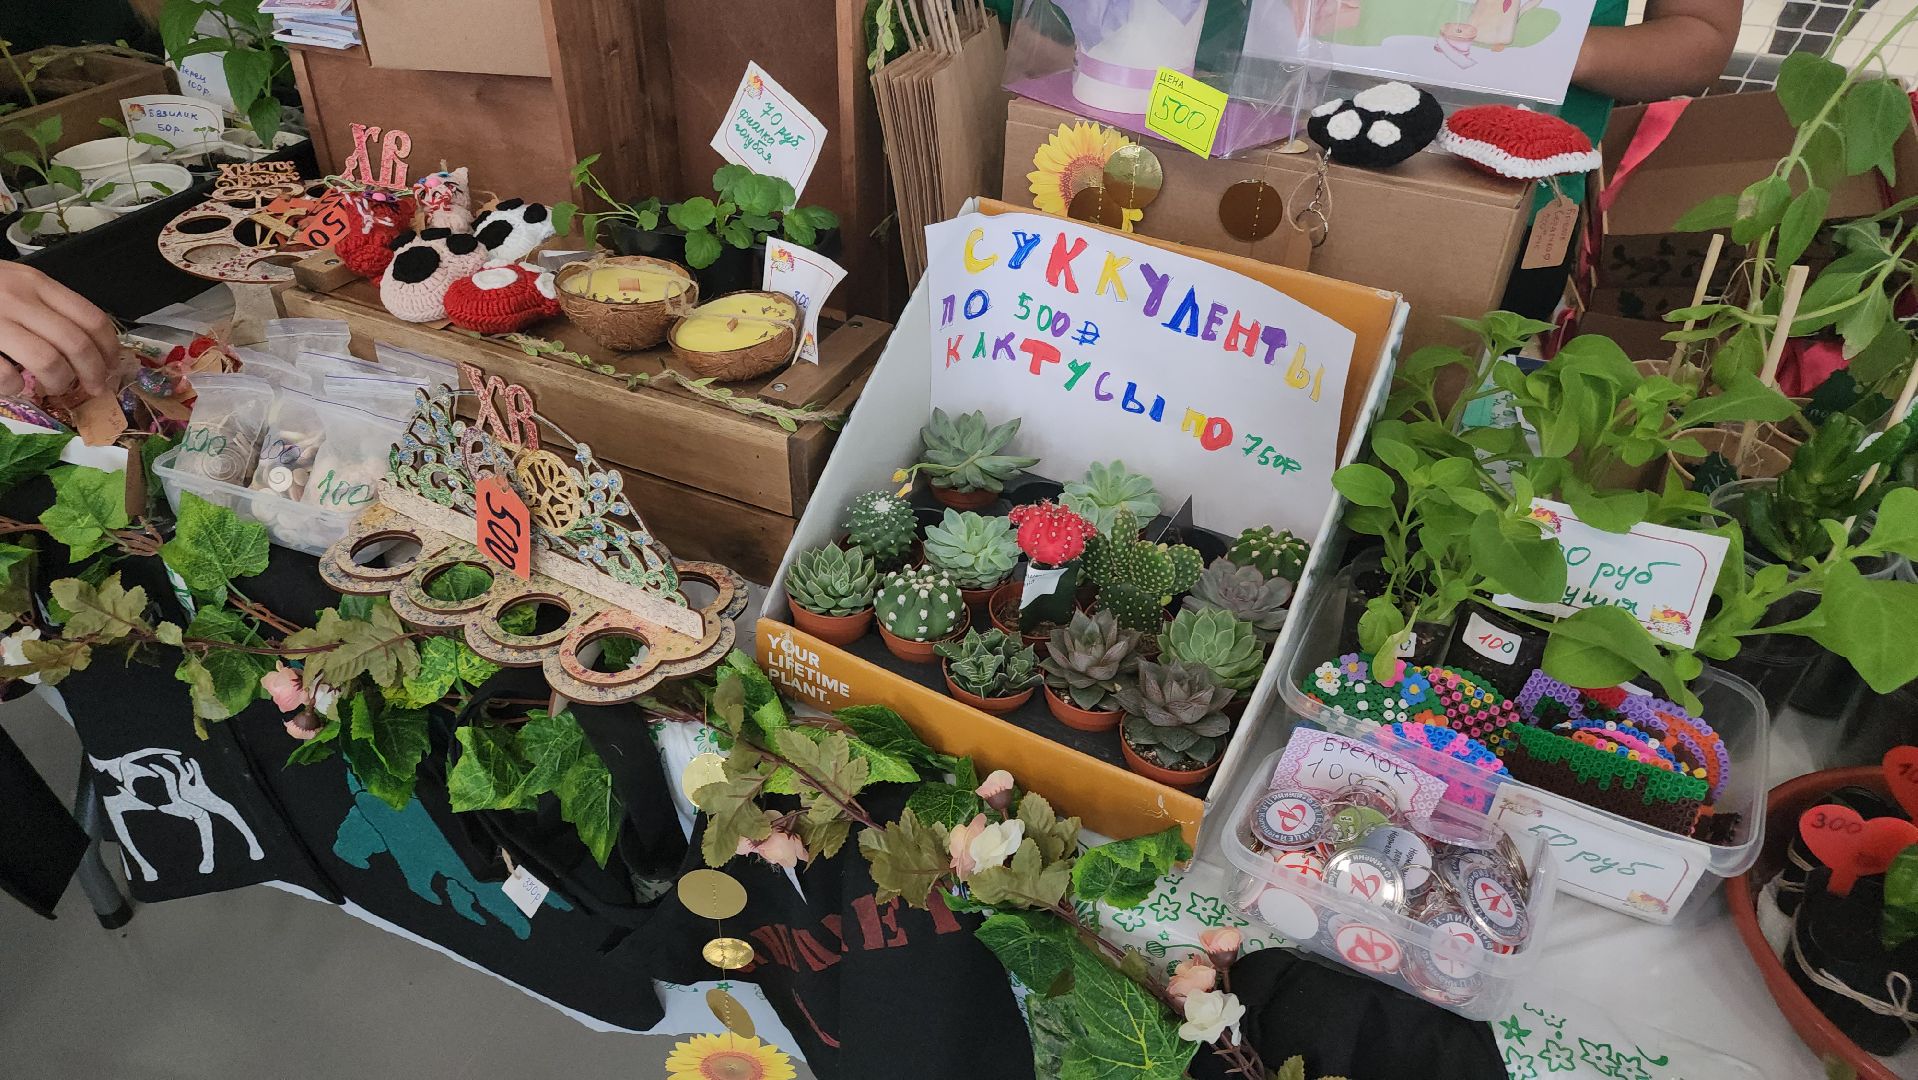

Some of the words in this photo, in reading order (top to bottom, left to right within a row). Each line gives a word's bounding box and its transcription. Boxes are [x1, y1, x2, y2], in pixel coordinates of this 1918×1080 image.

[1160, 71, 1184, 89] ЦЕНА
[760, 102, 783, 126] 70
[1154, 95, 1206, 130] 500
[735, 123, 772, 165] голубая
[941, 288, 992, 329] ПО
[964, 227, 1326, 402] СУККУЛЕНТЫ
[946, 332, 1166, 422] КАКТУСЫ
[1181, 407, 1234, 452] ПО
[317, 469, 374, 505] 100
[485, 492, 522, 571] 500
[1589, 562, 1681, 591] руб
[767, 633, 820, 668] YOUR
[1478, 633, 1514, 654] 100
[768, 651, 850, 698] LIFETIME
[768, 668, 831, 705] PLANT.
[1307, 758, 1364, 786] 100
[1811, 812, 1862, 834] 300
[1565, 850, 1665, 875] руб
